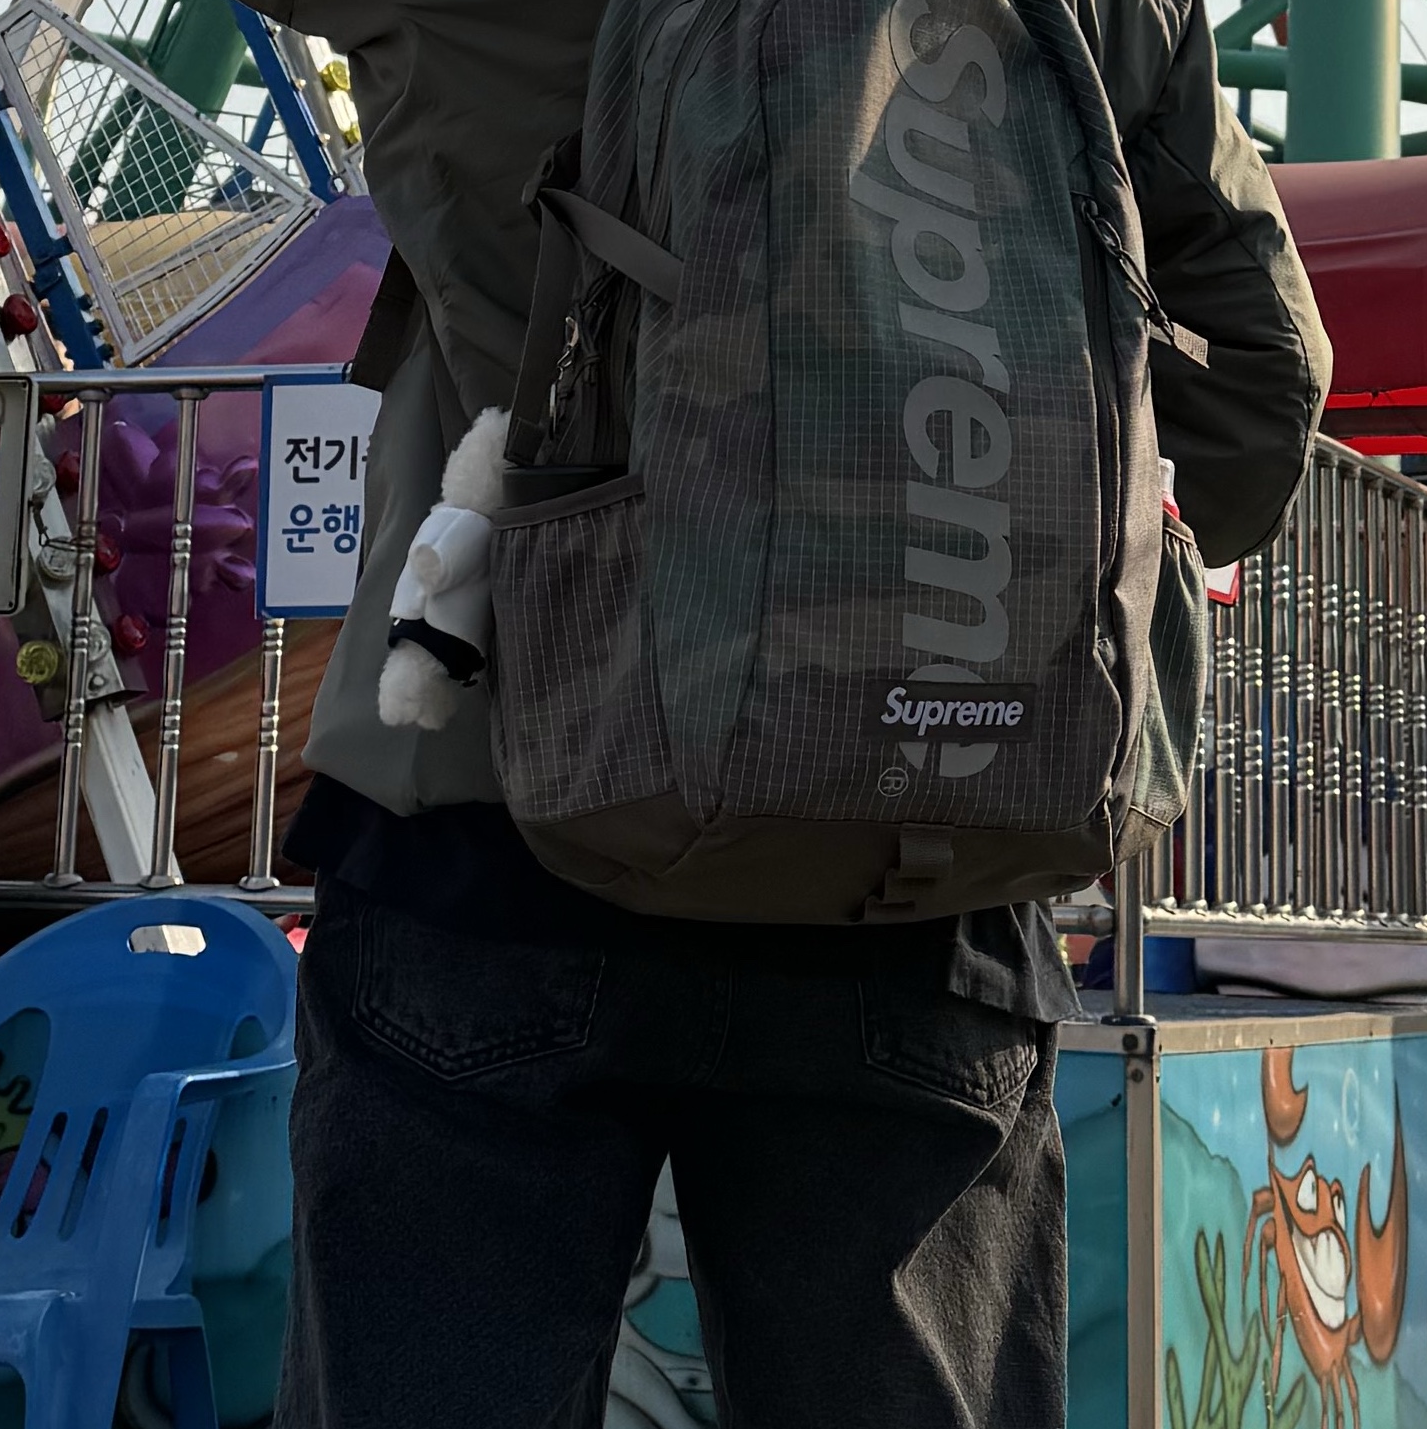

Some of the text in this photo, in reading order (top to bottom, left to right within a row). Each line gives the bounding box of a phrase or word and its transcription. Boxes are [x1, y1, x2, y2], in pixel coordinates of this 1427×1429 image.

[285, 436, 368, 484] 전기
[282, 504, 360, 554] 운행
[881, 687, 1024, 736] Supreme
